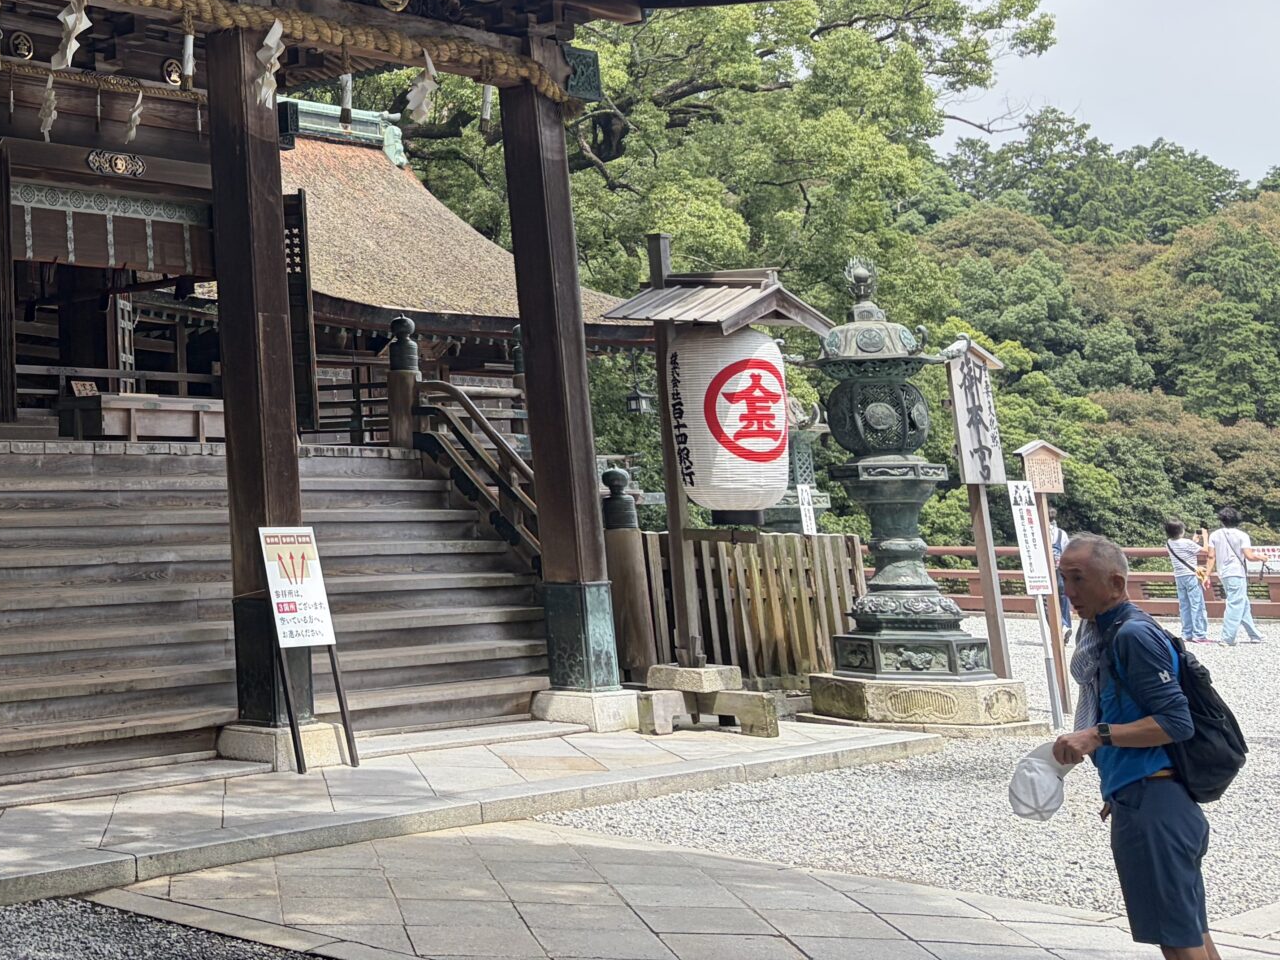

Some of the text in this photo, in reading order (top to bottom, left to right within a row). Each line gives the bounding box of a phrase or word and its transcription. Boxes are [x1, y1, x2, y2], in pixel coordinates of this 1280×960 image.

[721, 373, 782, 442] 金
[959, 351, 993, 481] 御本宮
